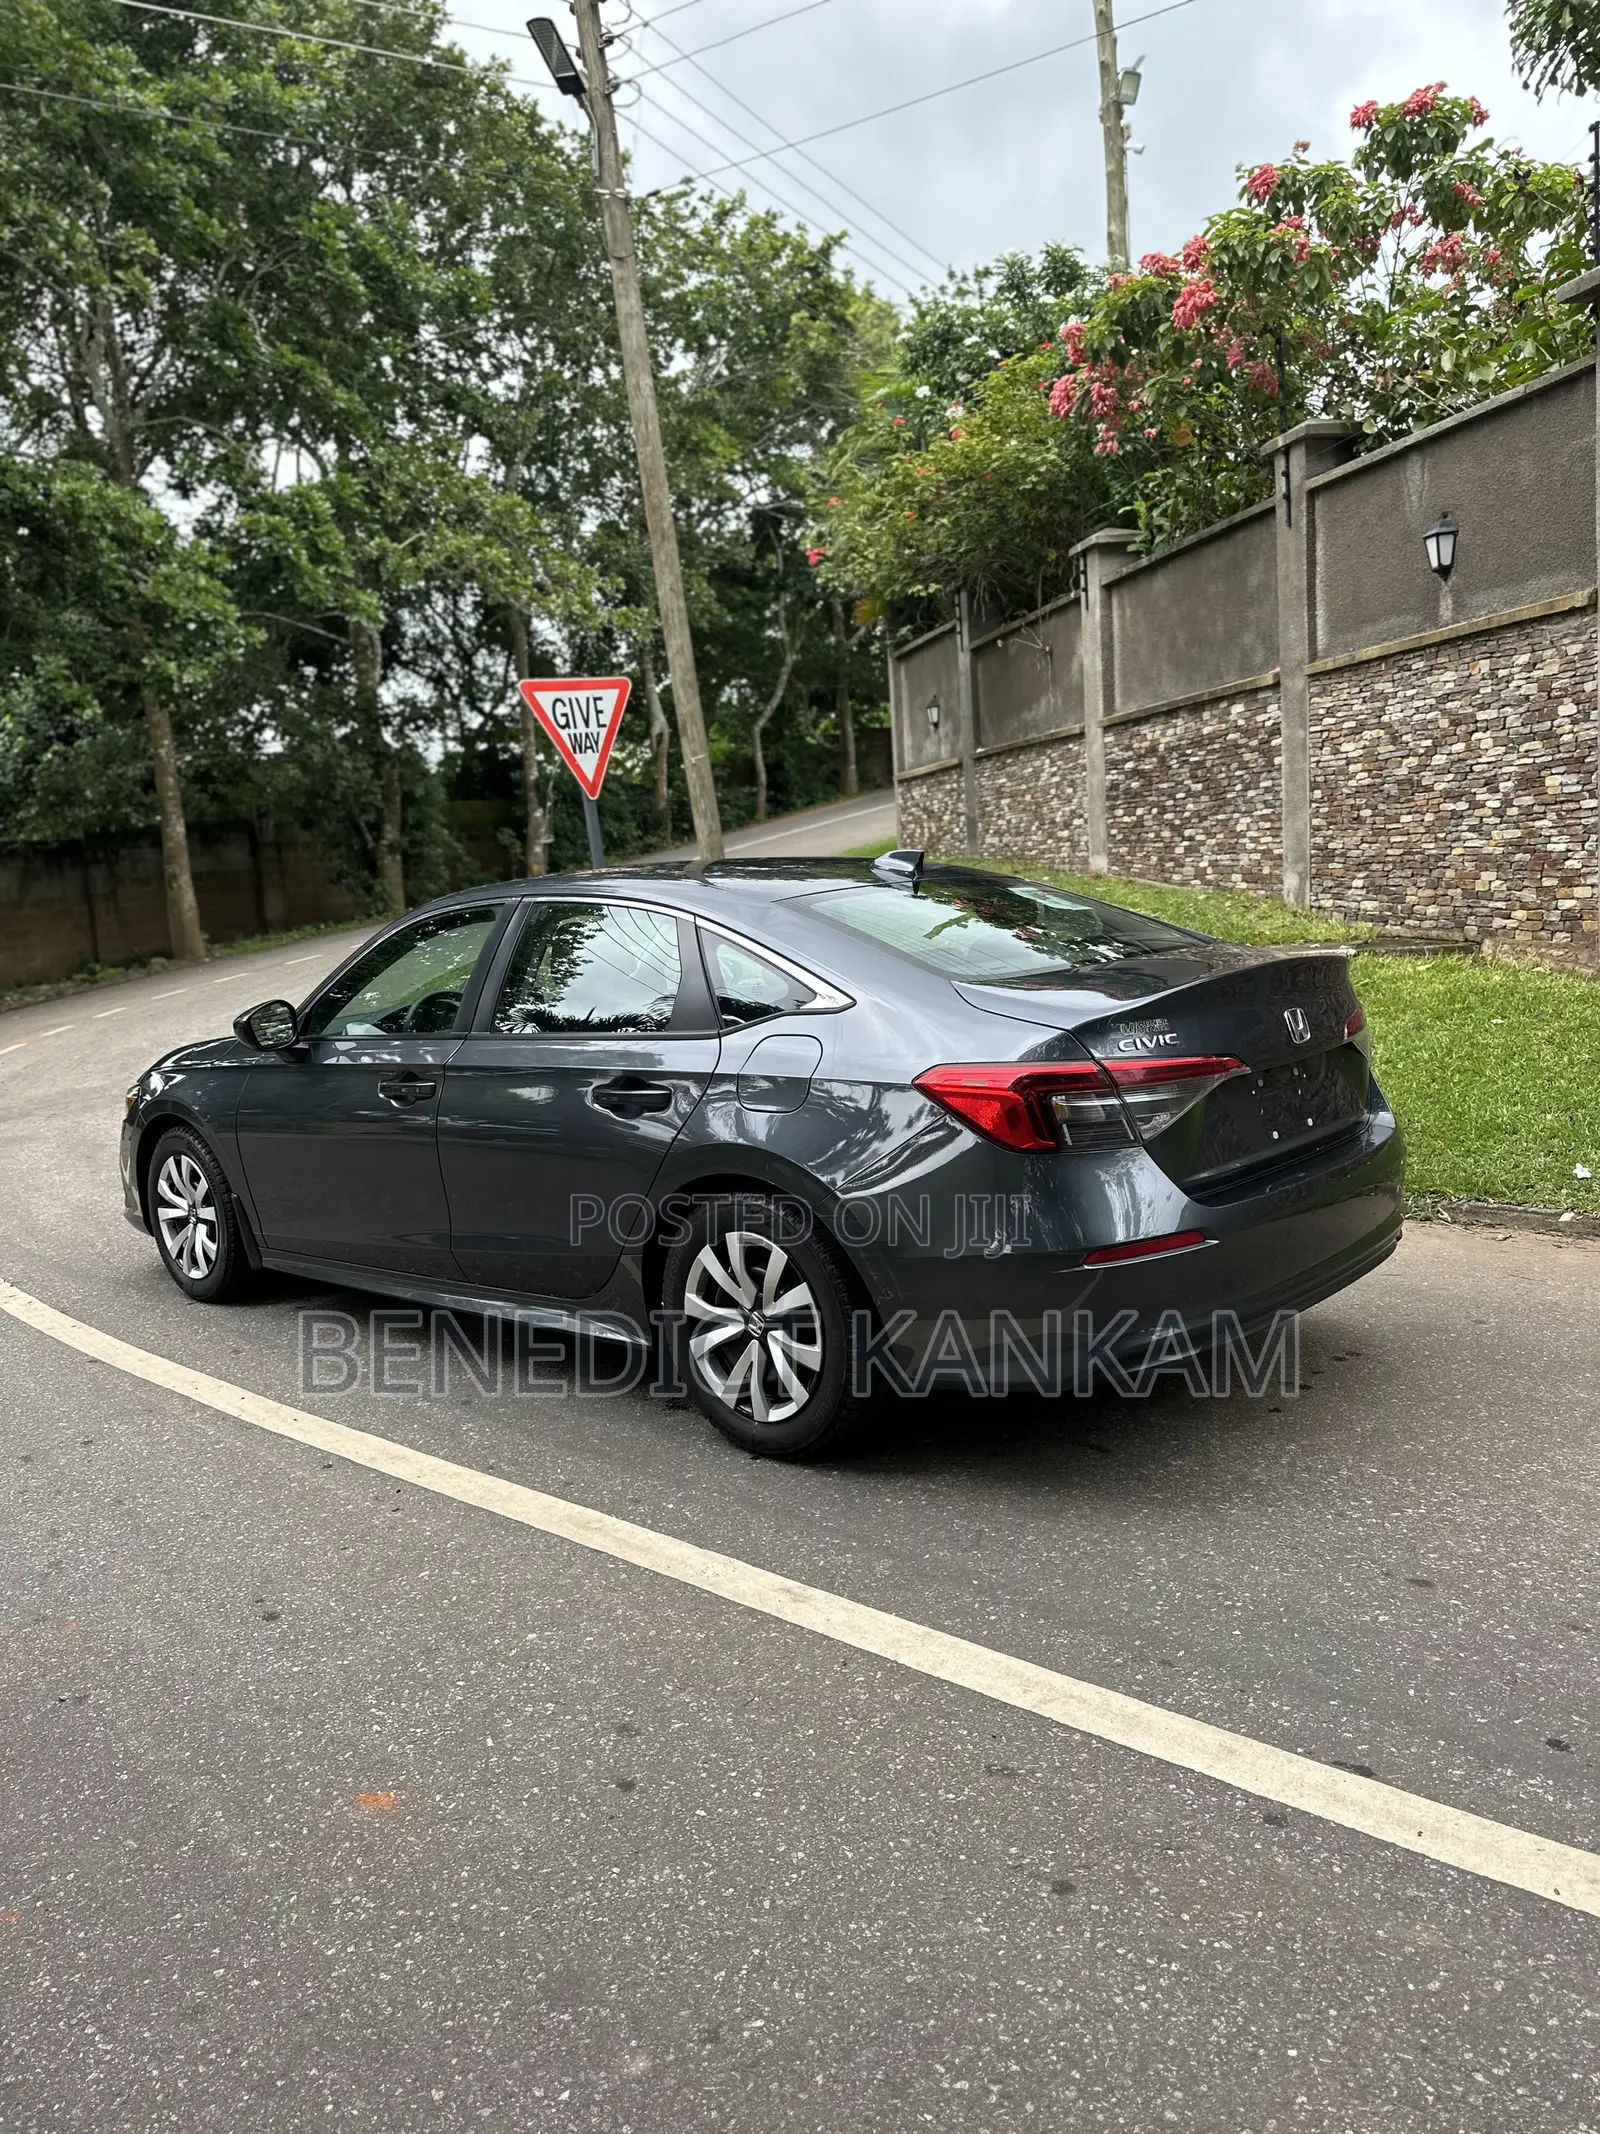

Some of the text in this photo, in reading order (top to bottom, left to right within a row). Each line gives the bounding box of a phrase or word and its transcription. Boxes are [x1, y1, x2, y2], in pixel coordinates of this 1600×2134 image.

[552, 696, 607, 730] GIVE
[568, 731, 600, 754] WAY
[1118, 1033, 1180, 1052] CIVIC
